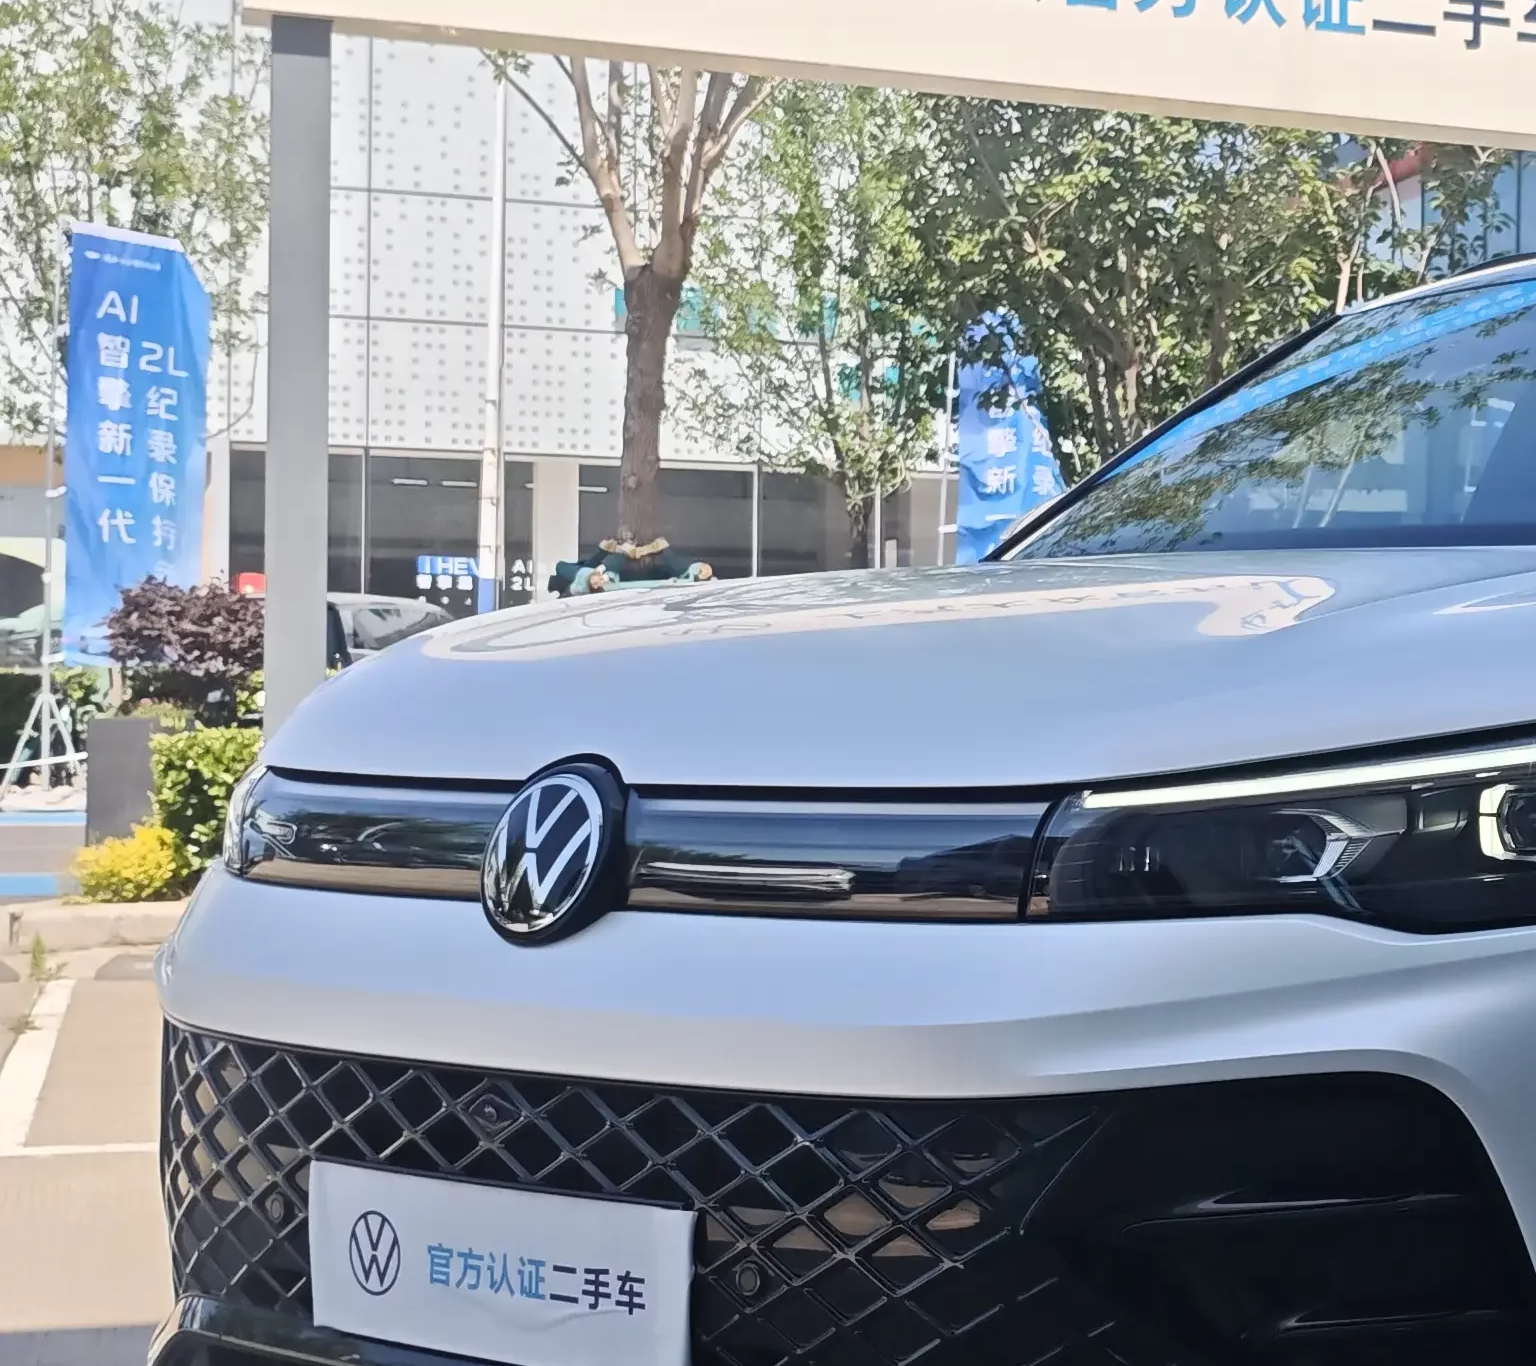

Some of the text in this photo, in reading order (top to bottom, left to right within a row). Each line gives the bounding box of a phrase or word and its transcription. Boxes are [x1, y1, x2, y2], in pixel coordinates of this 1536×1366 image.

[426, 1242, 647, 1316] 官方认证二手车
